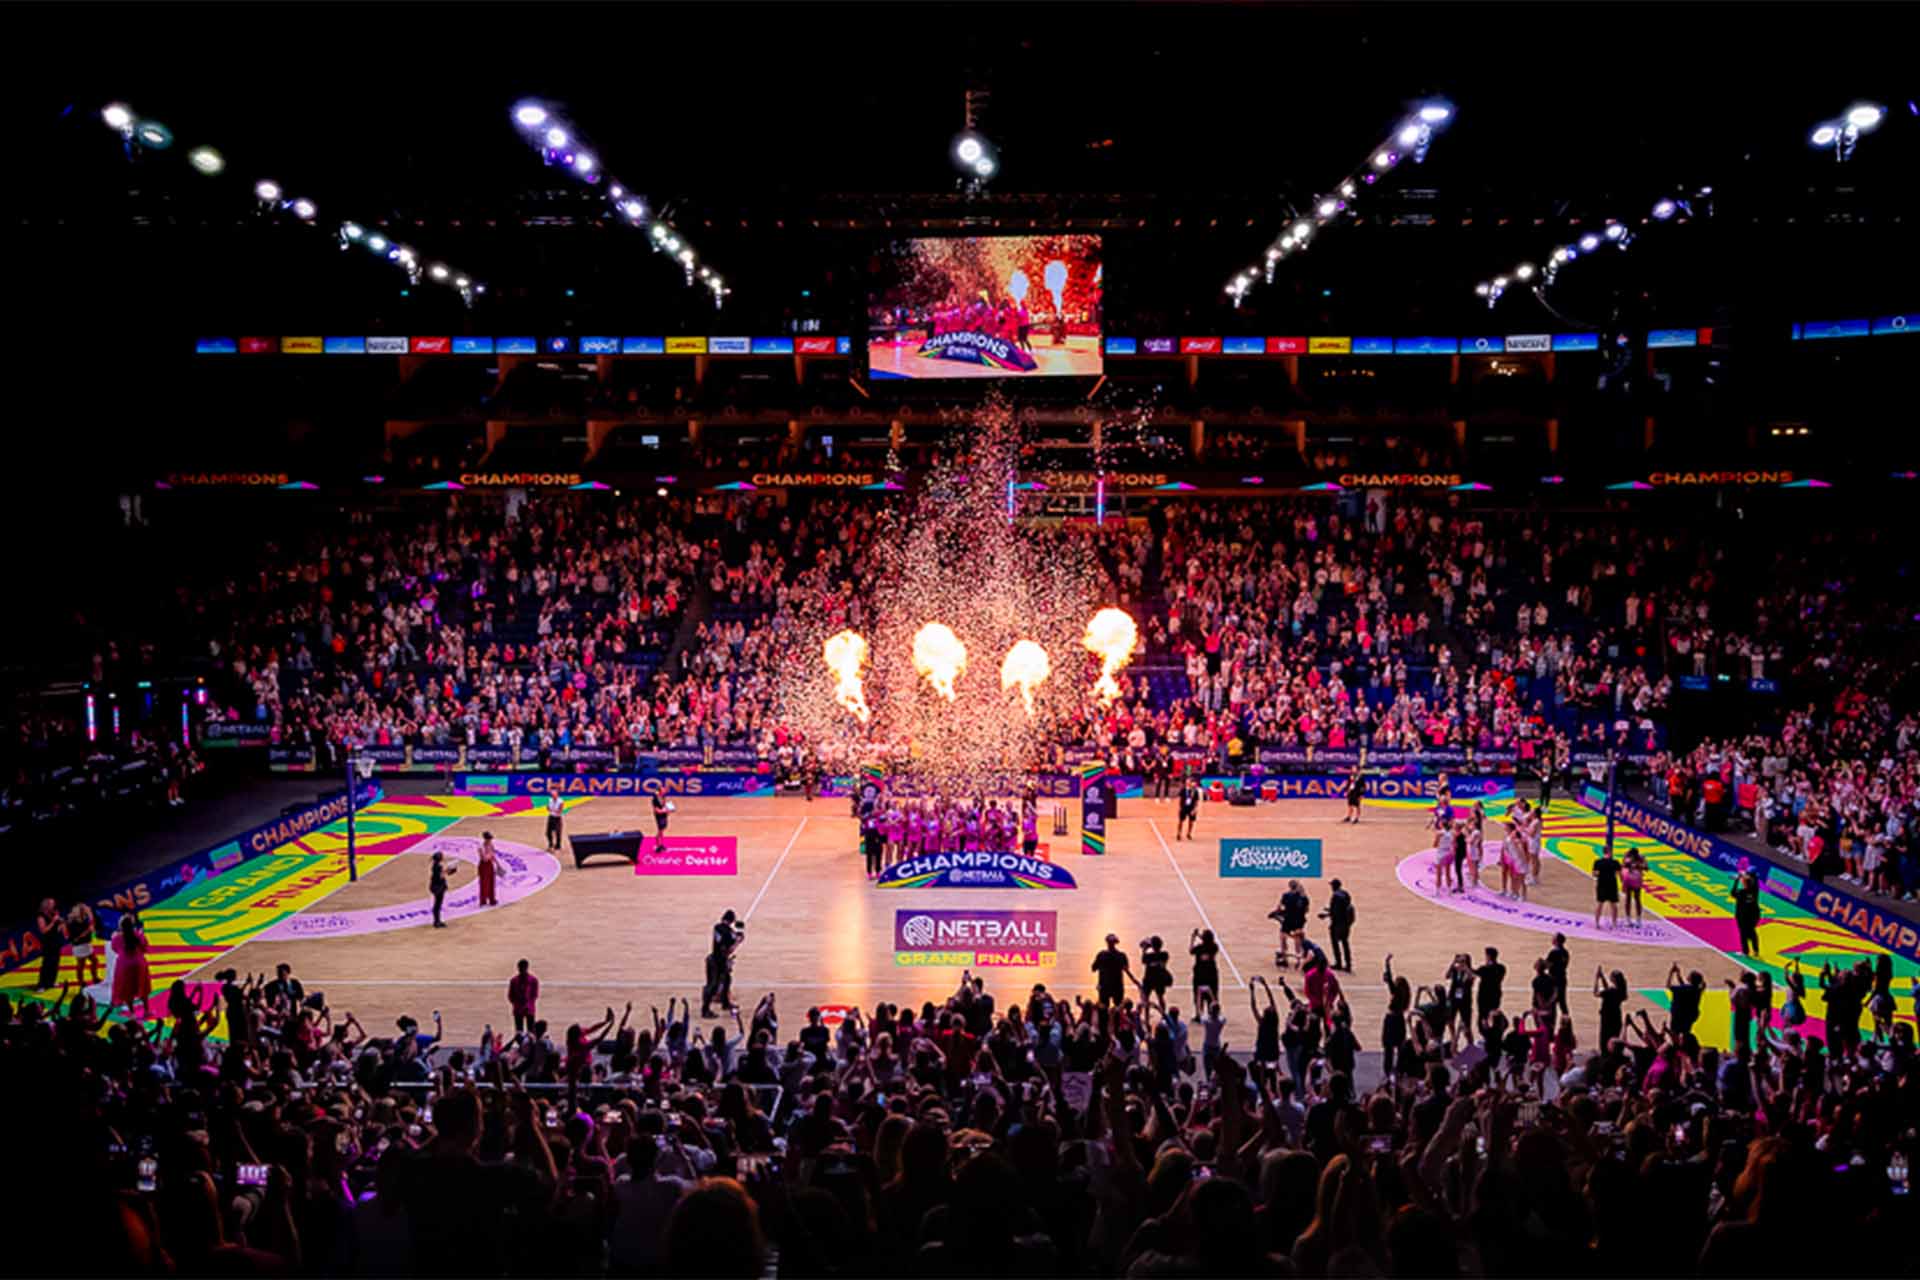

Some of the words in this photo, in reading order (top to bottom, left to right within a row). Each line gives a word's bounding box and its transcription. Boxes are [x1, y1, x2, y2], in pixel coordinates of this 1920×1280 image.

[925, 333, 1009, 359] CHAMPIONS
[459, 473, 581, 485] CHAMPIONS
[752, 473, 873, 485] CHAMPIONS
[1339, 473, 1461, 486] CHAMPIONS
[1648, 470, 1793, 484] CHAMPIONS
[526, 777, 703, 793] CHAMPIONS
[685, 855, 728, 865] Doctor
[896, 853, 1053, 879] CHAMPIONS
[938, 920, 1049, 938] NETBALL
[937, 938, 987, 947] SUPER
[991, 938, 1049, 947] LEAGUE
[897, 953, 973, 965] GRAND
[977, 953, 1037, 965] FINAL
